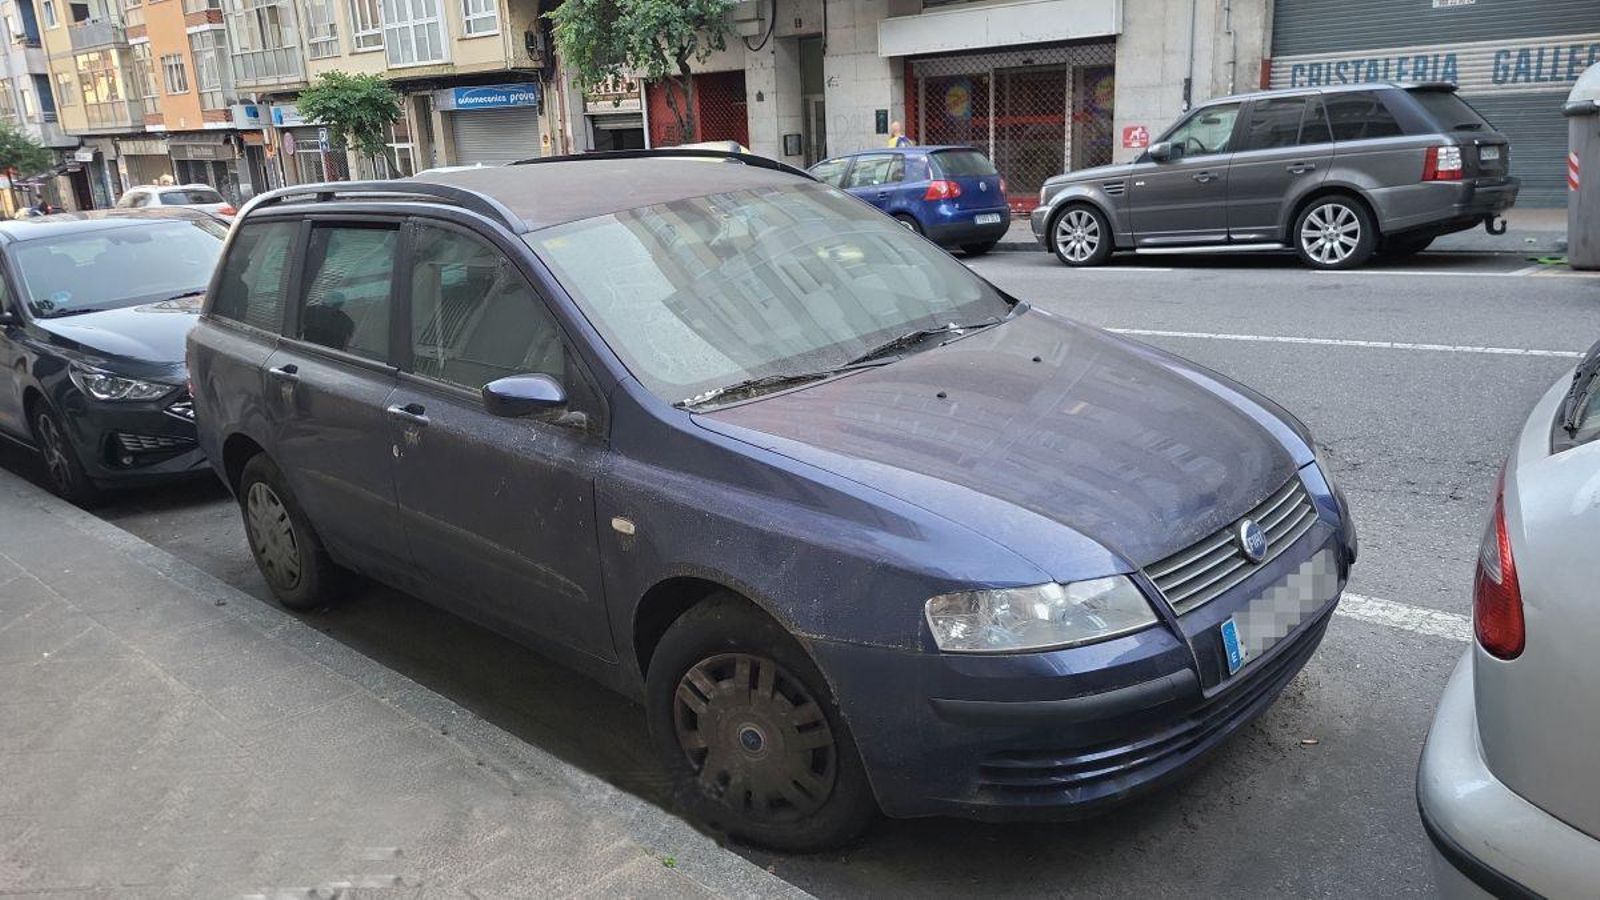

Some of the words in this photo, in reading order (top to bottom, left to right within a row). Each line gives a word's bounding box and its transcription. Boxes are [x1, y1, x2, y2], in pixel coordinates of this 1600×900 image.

[510, 92, 535, 103] prova
[1247, 530, 1264, 551] FIAT
[1232, 652, 1238, 663] E
